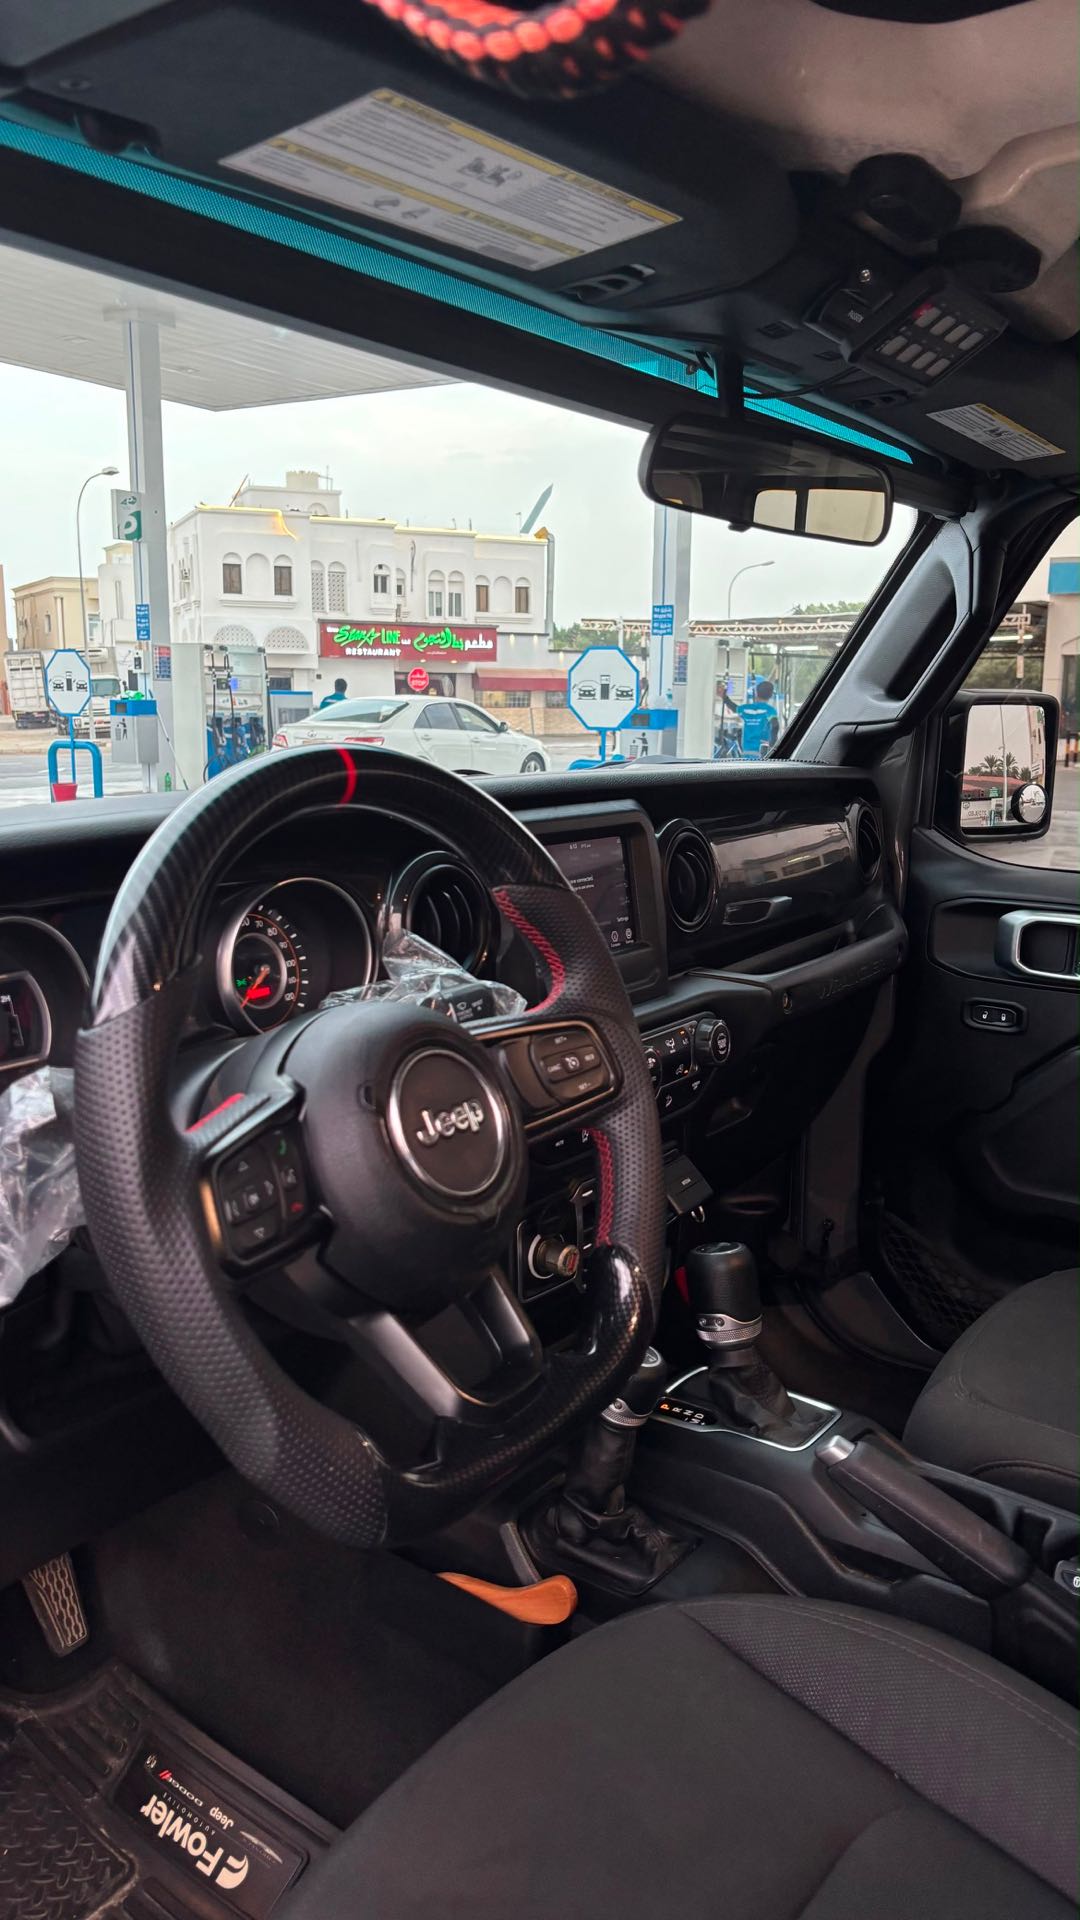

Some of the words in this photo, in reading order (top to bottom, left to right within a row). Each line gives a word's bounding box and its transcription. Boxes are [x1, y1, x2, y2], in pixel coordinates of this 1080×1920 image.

[381, 627, 401, 645] LINE
[464, 633, 494, 651] مطعم
[345, 647, 402, 657] RESTAURANT
[254, 920, 264, 928] 70
[267, 927, 278, 936] 80
[286, 959, 296, 967] 100
[284, 992, 296, 1001] 120
[416, 1099, 485, 1147] Jeep
[162, 1791, 216, 1836] AUTOMOTIVE
[209, 1806, 234, 1830] Jeep
[139, 1793, 224, 1877] Fowler
